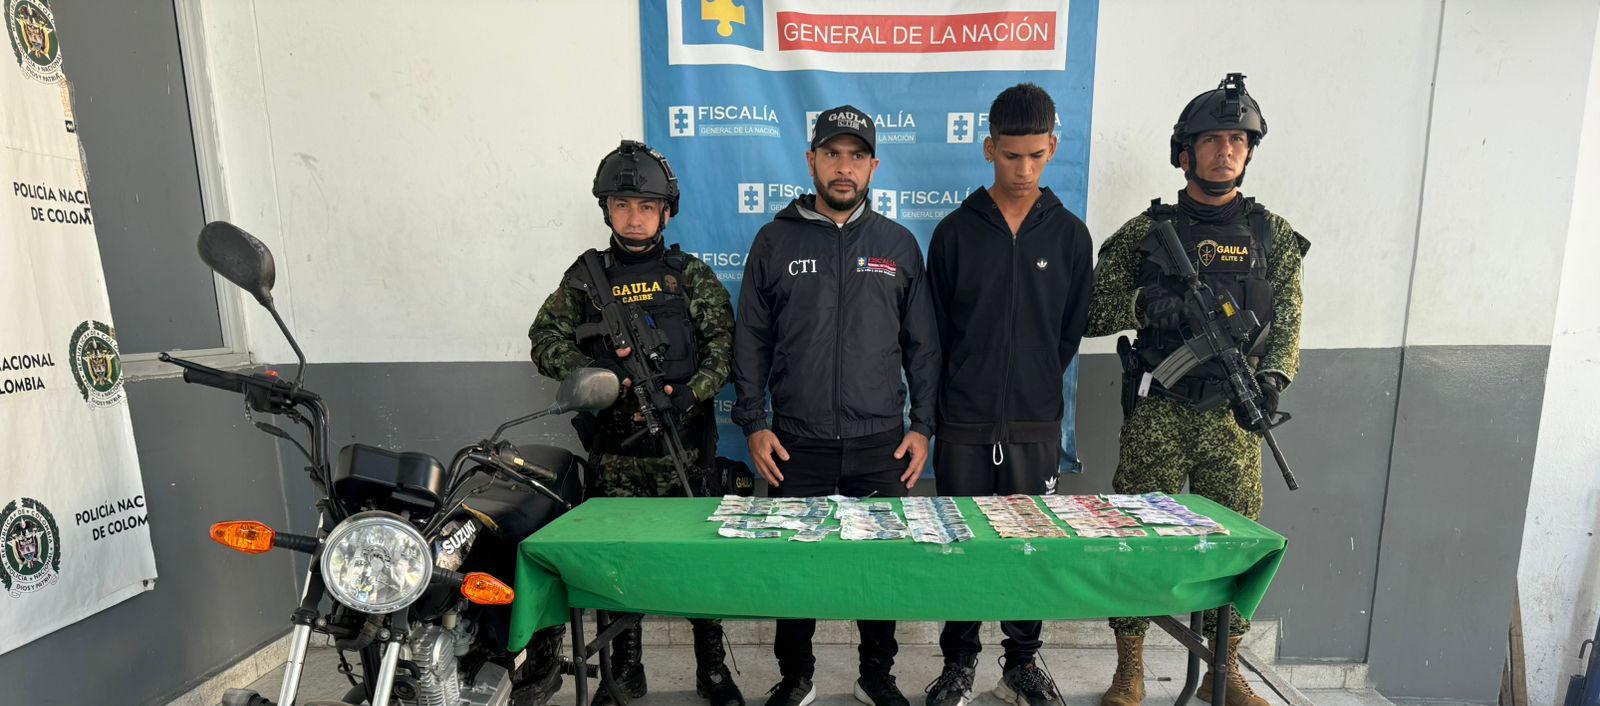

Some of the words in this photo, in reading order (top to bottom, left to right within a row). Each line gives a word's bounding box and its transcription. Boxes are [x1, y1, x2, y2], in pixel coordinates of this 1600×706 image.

[783, 22, 887, 44] GENERAL
[893, 26, 922, 45] DE
[930, 25, 957, 45] LA
[962, 17, 1049, 43] NACIÓN
[698, 105, 779, 123] FISCALÍA
[828, 111, 867, 128] GAULA
[874, 110, 916, 128] ALÍA
[754, 126, 779, 136] NACIÓN
[13, 181, 57, 202] POLICÍA
[59, 188, 89, 204] NACI
[31, 206, 45, 221] DE
[1216, 246, 1248, 255] GAULA
[788, 259, 817, 276] CTI
[612, 281, 662, 297] GAULA
[622, 293, 653, 304] CARIBE
[0, 353, 55, 371] ACIONAL
[75, 500, 116, 526] POLICÍA
[117, 495, 145, 513] NAC
[92, 526, 106, 541] DE
[442, 519, 477, 555] SUZUKI
